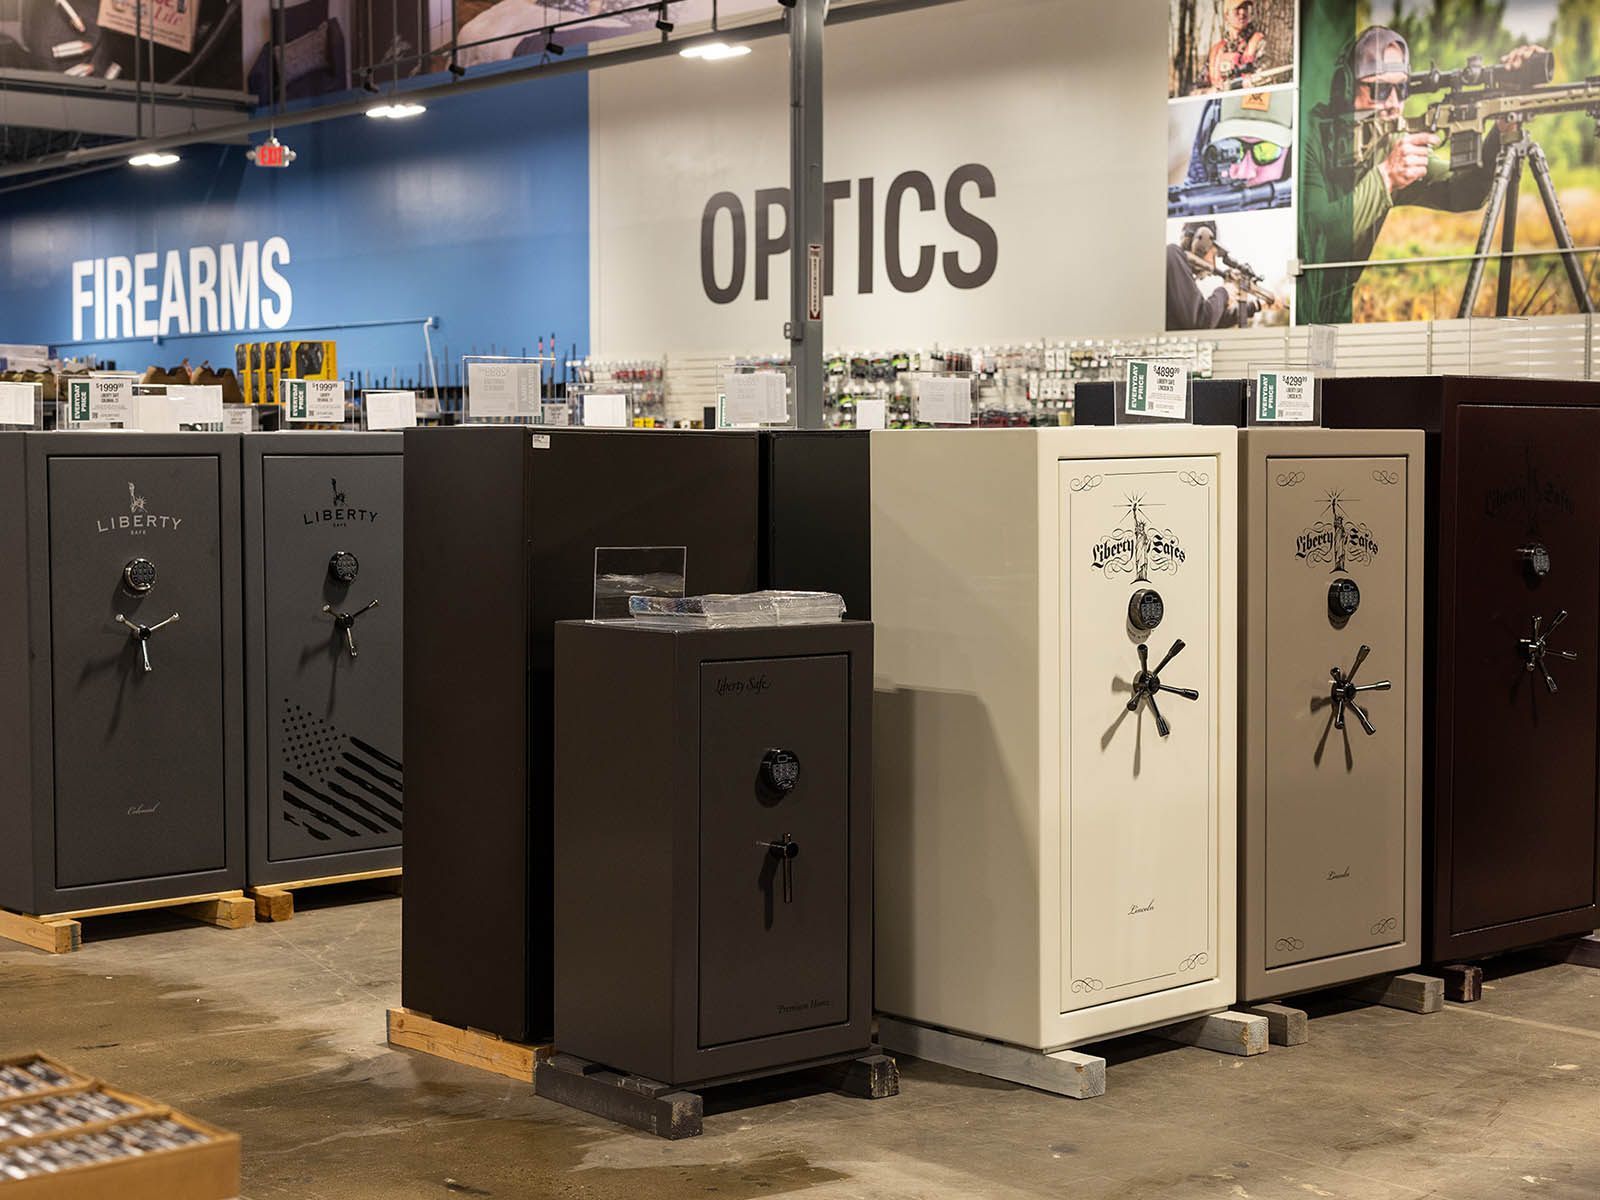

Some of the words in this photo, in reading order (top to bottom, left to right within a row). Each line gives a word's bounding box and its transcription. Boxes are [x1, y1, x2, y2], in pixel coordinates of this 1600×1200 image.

[260, 146, 283, 166] EXIT
[700, 163, 998, 305] OPTICS
[72, 236, 293, 341] FIREARMS
[1131, 364, 1139, 409] EVERYDAY
[1137, 374, 1145, 400] PRICE
[97, 514, 181, 533] LIBERTY
[303, 508, 378, 525] LIBERTY
[1092, 539, 1134, 568] Liberty
[1146, 534, 1186, 562] Safes
[1296, 531, 1334, 559] Liberty
[1344, 528, 1379, 555] Safes
[716, 675, 746, 696] Liberty
[1127, 898, 1156, 916] Lincoln
